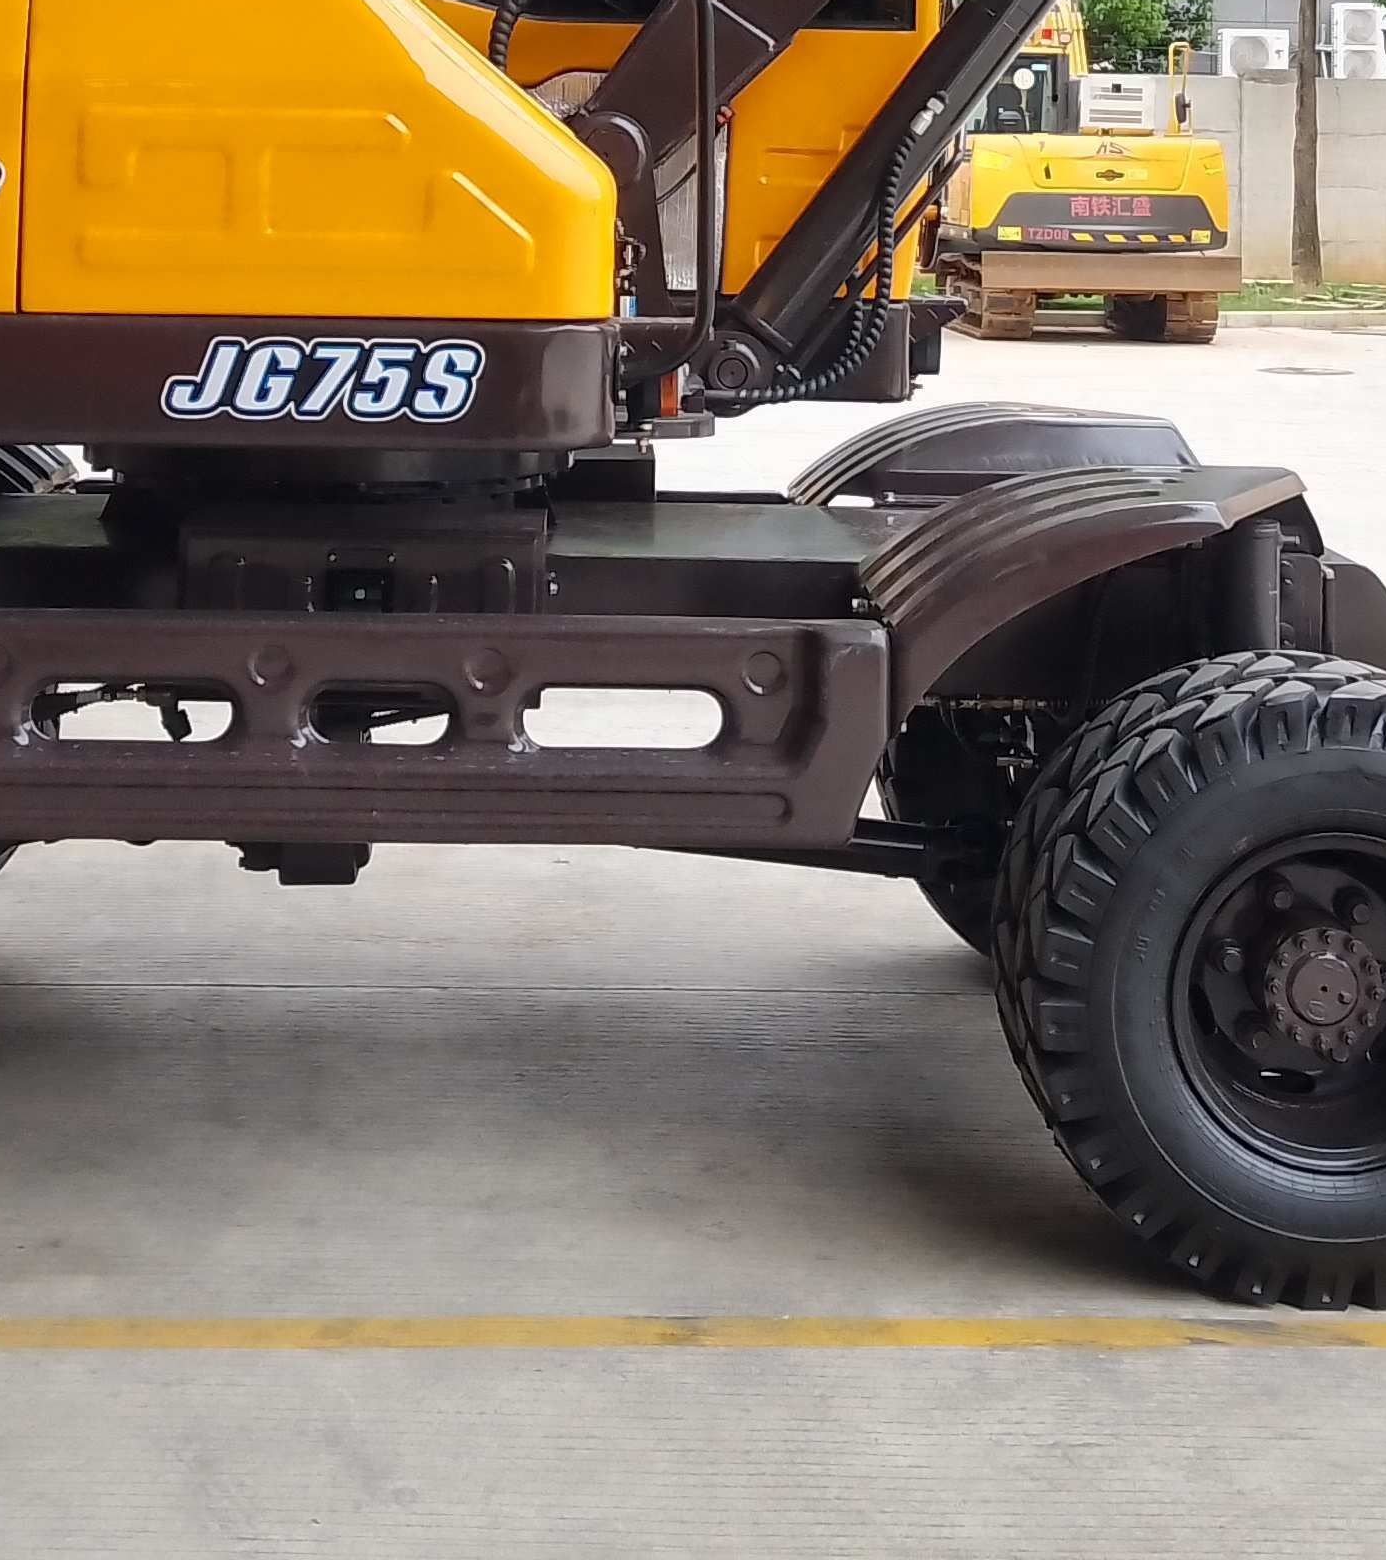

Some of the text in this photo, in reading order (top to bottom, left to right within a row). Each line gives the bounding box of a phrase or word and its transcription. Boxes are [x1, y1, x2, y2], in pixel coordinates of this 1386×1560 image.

[1069, 196, 1152, 217] 南铁汇盛
[167, 342, 481, 416] JG75S
